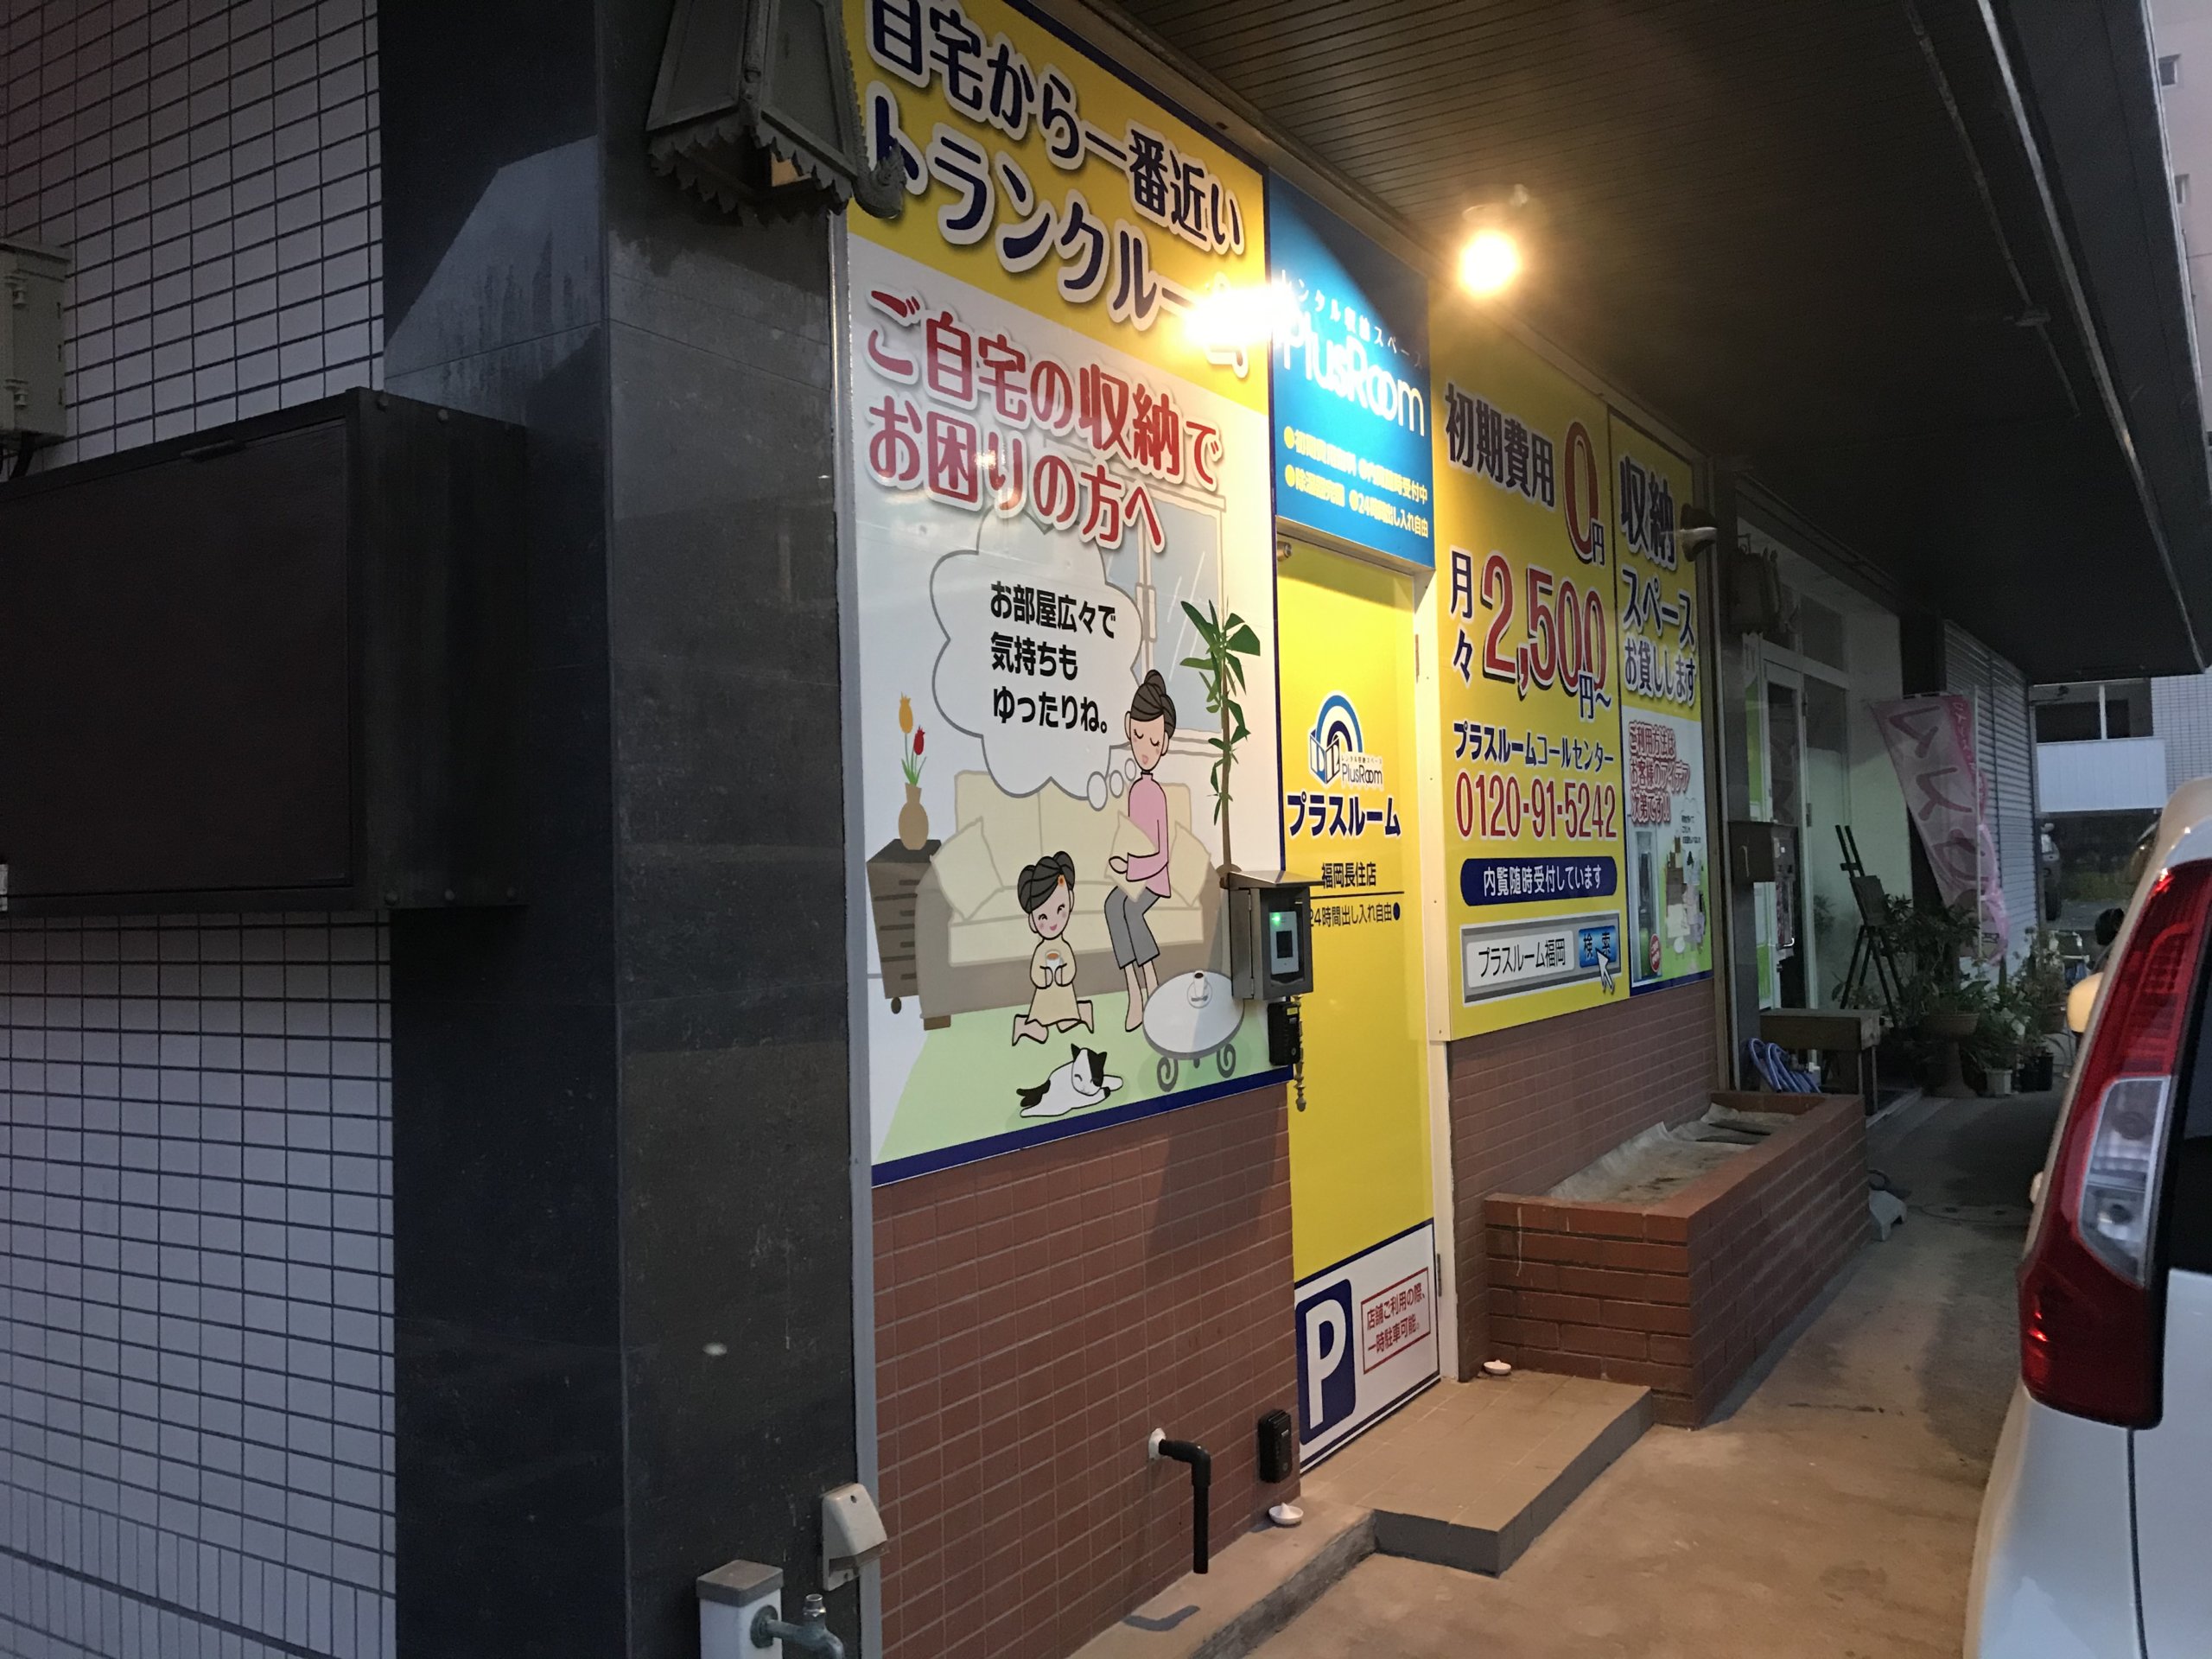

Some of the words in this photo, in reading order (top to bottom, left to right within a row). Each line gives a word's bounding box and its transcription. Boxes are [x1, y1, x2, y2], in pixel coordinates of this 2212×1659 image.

[875, 96, 1245, 367] トランクルー
[868, 290, 1219, 485] ご自宅の収納で
[868, 395, 1161, 547] お困りの方へ
[1446, 383, 1554, 507] 初期費用
[1620, 455, 1675, 564] 収納
[990, 581, 1116, 639] お部屋広々で
[1450, 550, 1473, 683] 月々
[1622, 569, 1695, 648] スペース
[990, 632, 1078, 681] 気持ちも
[1624, 638, 1696, 702] お貸しします
[993, 686, 1108, 734] ゆったりね。
[1453, 722, 1613, 771] プラスルームコールセンター
[1630, 721, 1675, 759] ご利用方法は
[1342, 763, 1382, 784] PlusRoom
[1287, 791, 1401, 837] プラスルーム
[1321, 861, 1376, 888] 福岡長住店
[1484, 865, 1602, 897] 内覧随時受付しています
[1478, 938, 1566, 978] プラスルーム福岡
[1306, 1299, 1346, 1430] P
